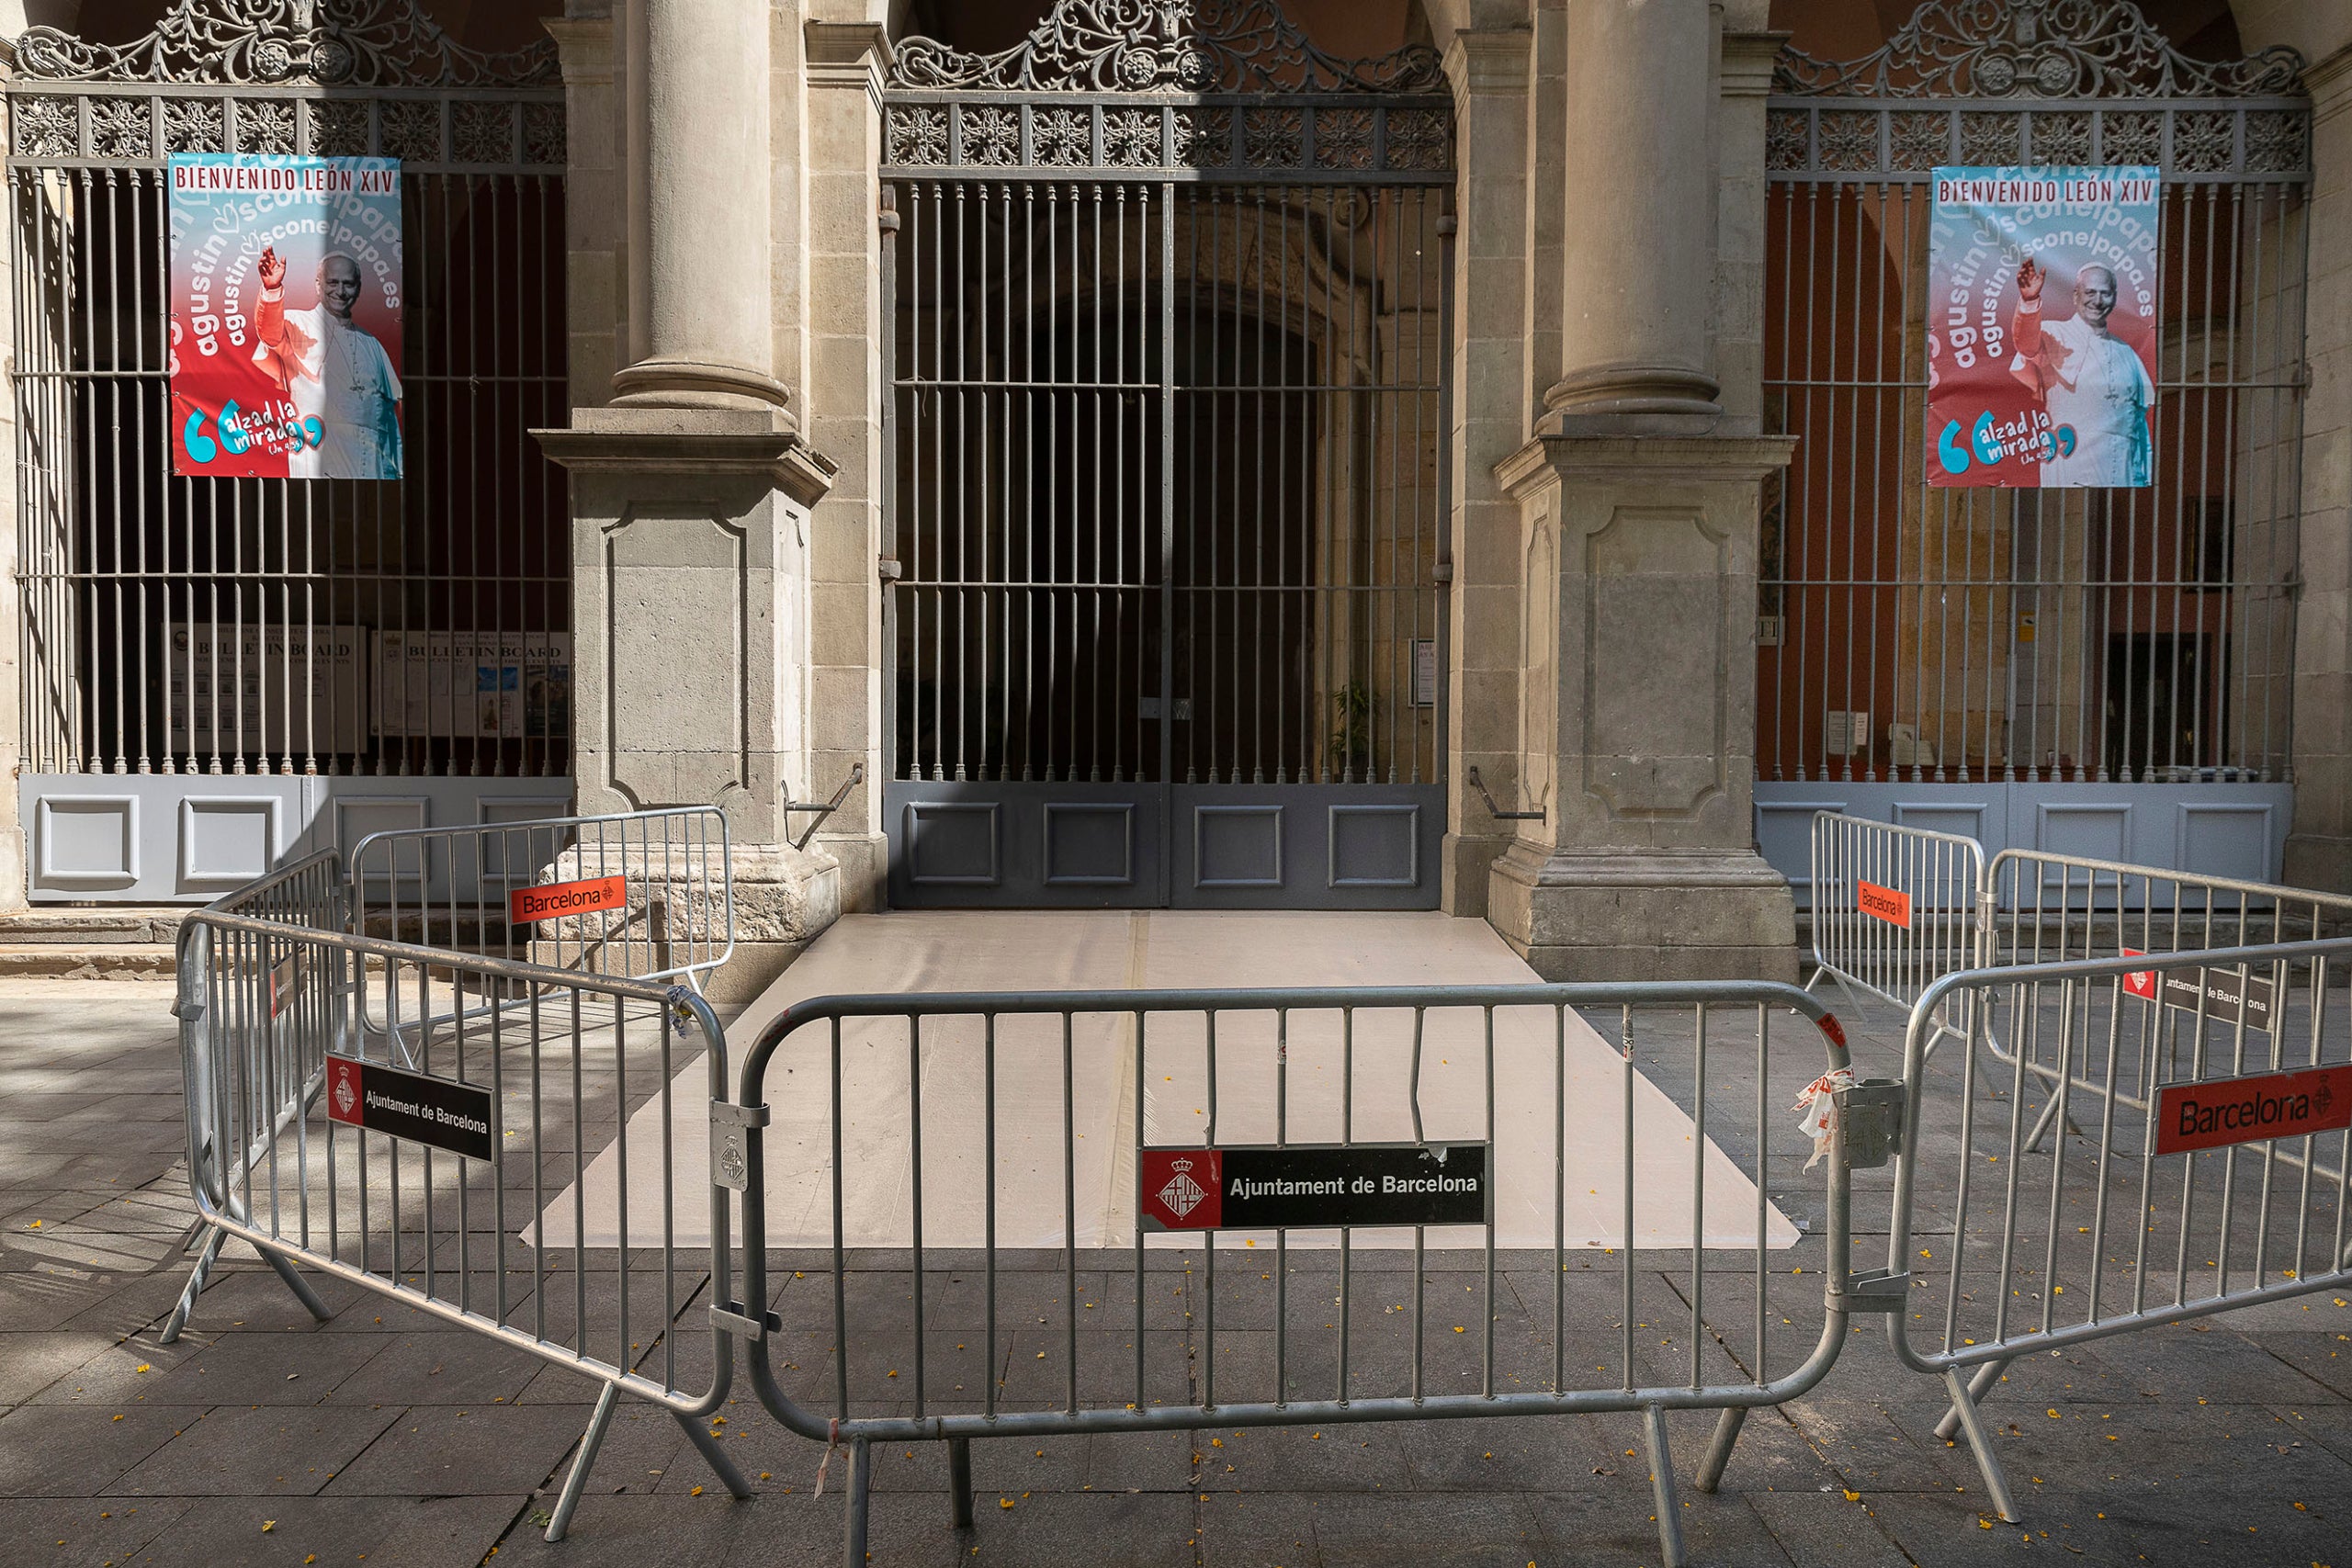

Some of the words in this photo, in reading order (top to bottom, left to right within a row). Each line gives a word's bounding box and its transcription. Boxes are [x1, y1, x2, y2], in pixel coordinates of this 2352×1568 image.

[175, 166, 295, 191] BIENVENIDO
[305, 164, 352, 193] LEÓN
[360, 170, 393, 193] XIV
[1939, 180, 2056, 202] BIENVENIDO
[2065, 175, 2112, 202] LEÓN
[2120, 180, 2152, 202] XIV
[224, 400, 274, 434] alzad
[277, 399, 297, 420] la
[1979, 412, 2029, 444] alzad
[2031, 409, 2051, 430] la
[233, 417, 298, 450] mirada
[1987, 426, 2052, 461] mirada
[198, 642, 285, 655] BLEIN
[523, 890, 601, 914] Barcelona
[1862, 888, 1896, 916] Barcelona
[2217, 989, 2267, 1011] Barcona
[366, 1089, 420, 1118] Ajuntament
[421, 1105, 434, 1121] de
[436, 1107, 487, 1134] Barcelona
[2178, 1091, 2310, 1136] Barcelona
[1229, 1176, 1345, 1201] Ajuntament
[1351, 1176, 1375, 1194] de
[1383, 1174, 1477, 1193] Barcelona
